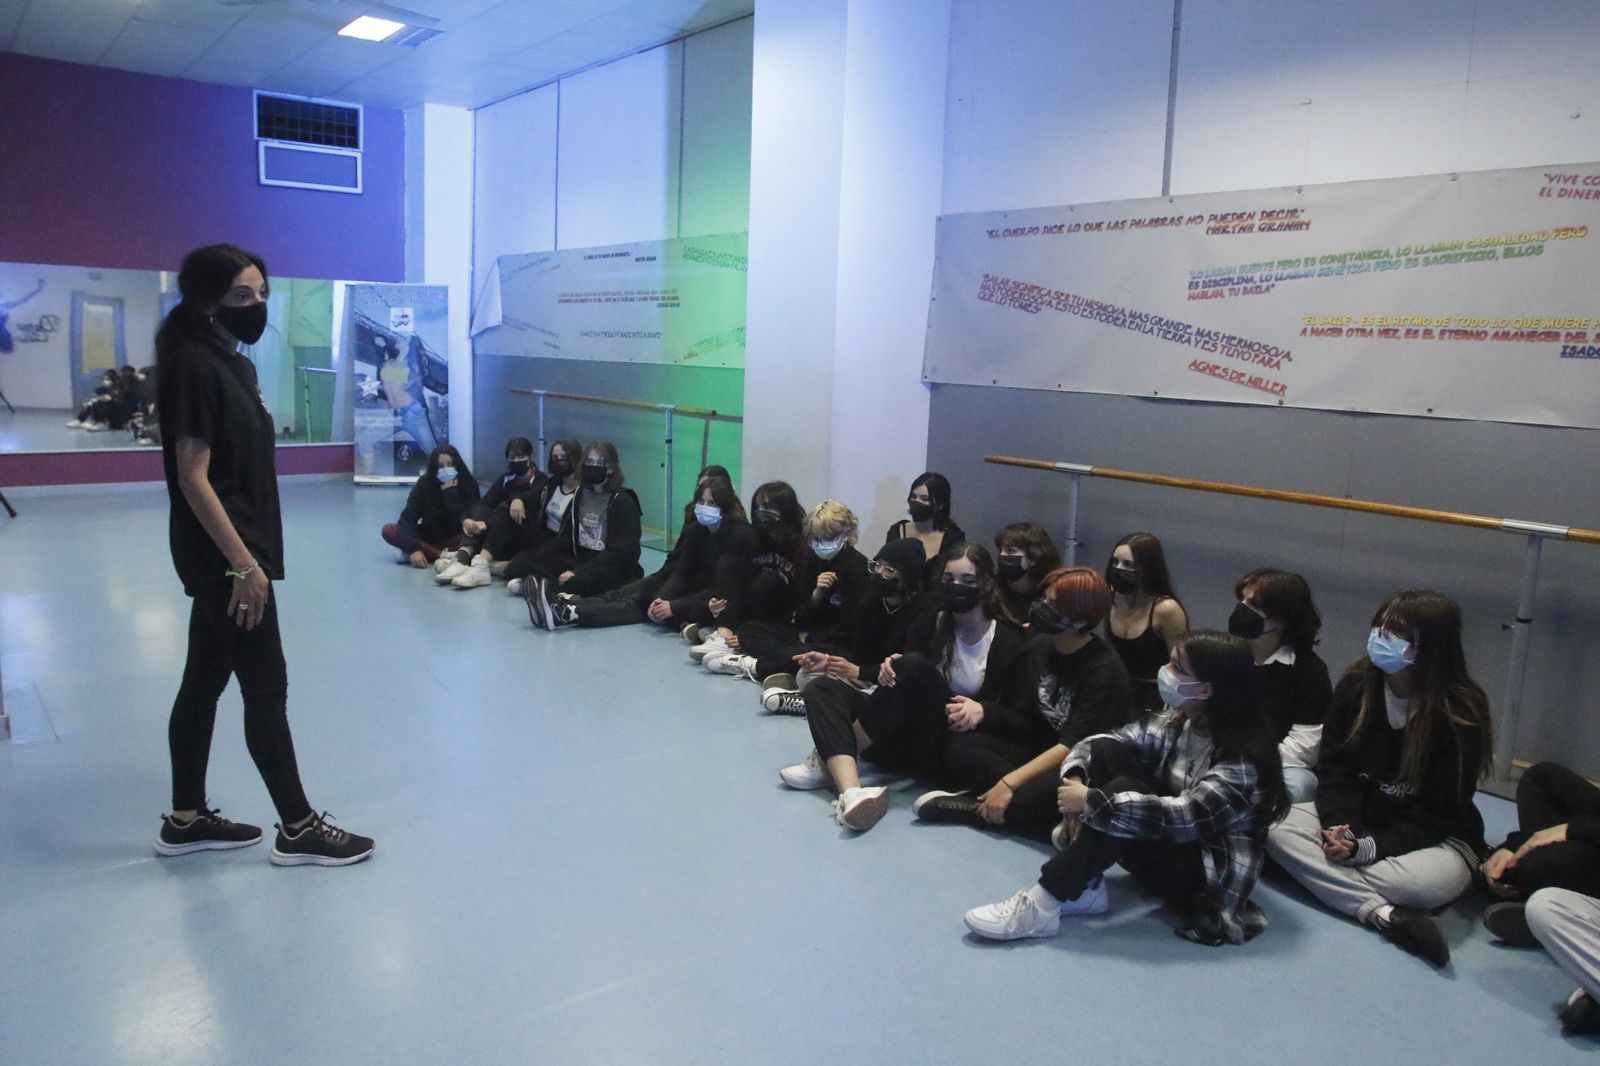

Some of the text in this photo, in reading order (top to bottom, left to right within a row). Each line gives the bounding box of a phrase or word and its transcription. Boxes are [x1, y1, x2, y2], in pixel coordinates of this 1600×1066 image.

[1539, 187, 1552, 198] EL
[1002, 226, 1040, 238] CUERPO
[1041, 224, 1065, 236] DICE
[1066, 223, 1082, 233] LO
[1083, 221, 1104, 232] QUE
[1106, 219, 1128, 231] LAS
[1129, 216, 1184, 230] PALABRAS
[1186, 214, 1204, 226] NO
[1207, 211, 1257, 224] PUEDEN
[1206, 222, 1255, 235] MARTHA
[1276, 258, 1302, 270] PERO
[1303, 256, 1317, 266] ES
[1396, 246, 1412, 258] LO
[1414, 240, 1464, 255] LLAMAN
[1552, 225, 1589, 240] PERO
[1188, 280, 1200, 291] ES
[1259, 273, 1274, 283] LO
[1275, 267, 1315, 282] LLAMAN
[1503, 244, 1545, 259] ELLOS
[1228, 287, 1240, 297] TU
[1011, 280, 1052, 298] SIGNIFICA
[1052, 290, 1071, 303] SER
[1071, 294, 1085, 307] TU
[1127, 309, 1150, 324] MAS
[1195, 327, 1220, 342] MAS
[1360, 316, 1375, 327] ES
[1376, 316, 1391, 327] EL
[1393, 316, 1432, 328] RITMO
[1434, 316, 1450, 328] DE
[1454, 316, 1489, 328] TODO
[1491, 317, 1509, 328] LO
[1511, 318, 1541, 330] QUE
[1543, 318, 1590, 329] MUERE
[1055, 301, 1080, 316] ESTO
[1080, 308, 1094, 320] ES
[1094, 311, 1127, 328] PODER
[1127, 319, 1143, 332] EN
[1143, 323, 1154, 336] LA
[1156, 327, 1191, 346] TIERRA
[1193, 338, 1202, 348] Y
[1201, 339, 1219, 351] ES
[1219, 344, 1251, 362] TUYO
[1251, 353, 1281, 371] PARA
[1300, 327, 1308, 337] A
[1310, 327, 1344, 338] NACER
[1345, 328, 1374, 338] OTRA
[1404, 328, 1420, 340] ES
[1422, 329, 1435, 340] EL
[1438, 329, 1489, 341] ETERNO
[1491, 330, 1561, 343] AMANECER
[1565, 331, 1589, 343] DEL
[1188, 359, 1287, 396] AGNES DE MILLER
